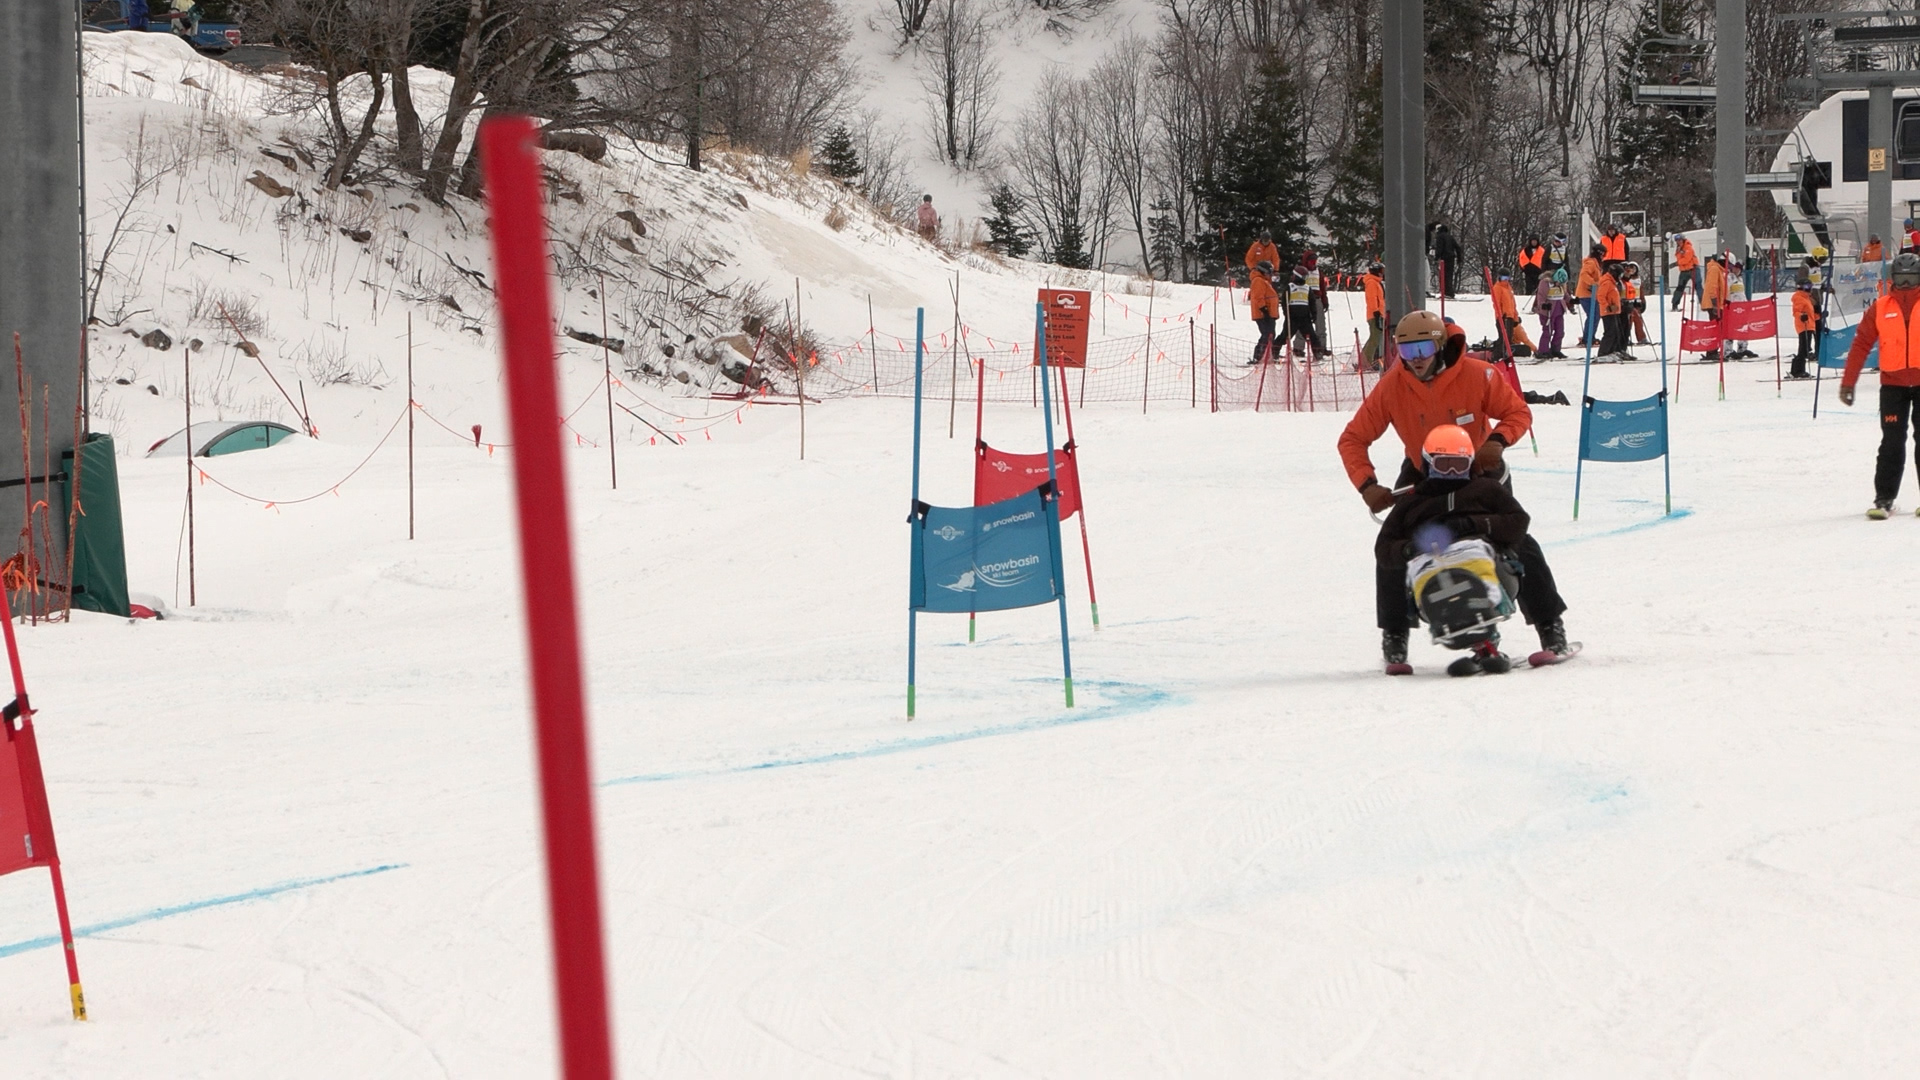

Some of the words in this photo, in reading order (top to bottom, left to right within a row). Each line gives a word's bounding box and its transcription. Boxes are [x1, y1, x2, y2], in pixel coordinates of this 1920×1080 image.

[1623, 430, 1656, 439] snowbasin
[992, 511, 1035, 527] snowbasin
[981, 554, 1039, 573] snowbasin
[1002, 569, 1019, 577] team
